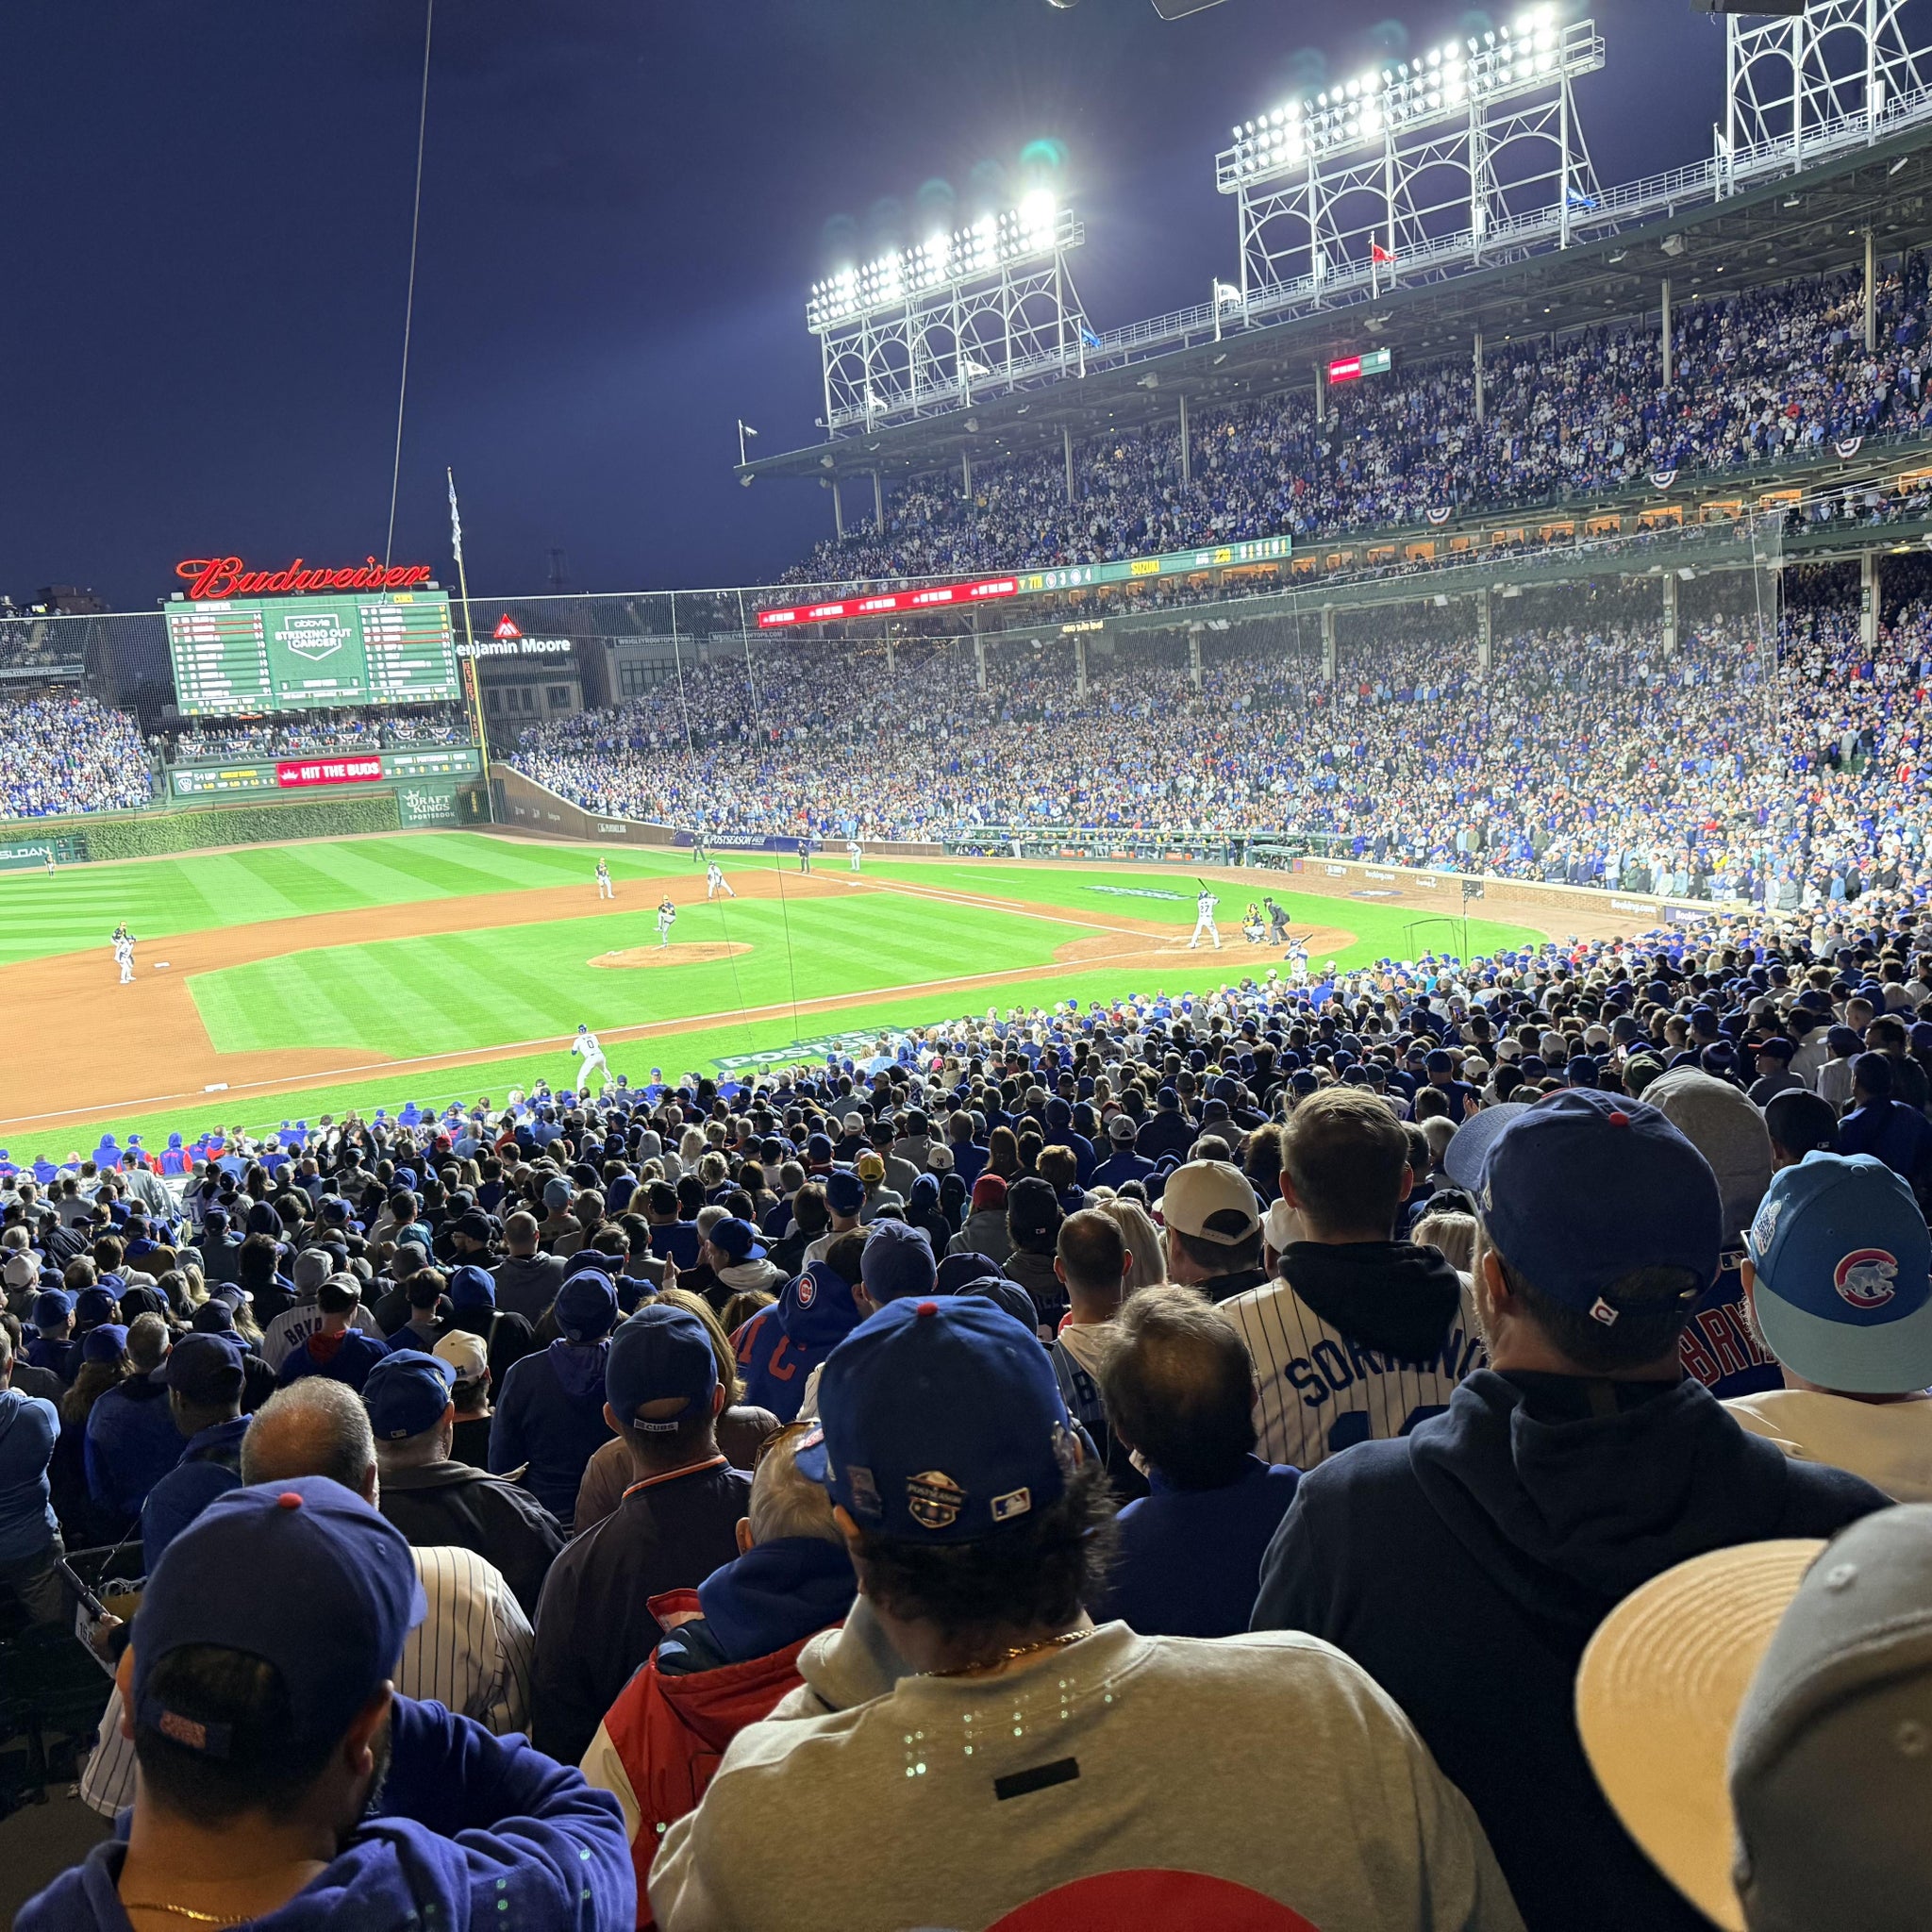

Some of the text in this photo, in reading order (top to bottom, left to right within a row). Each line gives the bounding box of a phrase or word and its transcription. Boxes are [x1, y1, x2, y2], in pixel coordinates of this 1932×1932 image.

[1131, 559, 1160, 575] SUZUKI
[175, 557, 430, 600] Budweiser
[275, 627, 352, 641] STRIKING OUT
[292, 638, 337, 648] CANCER
[456, 638, 571, 658] enjamin Moore
[300, 761, 380, 780] HIT THE BUDS
[407, 794, 451, 808] DRAFT
[413, 803, 451, 813] KINGS
[408, 811, 456, 822] SPORTSBOOK
[709, 834, 753, 846] POSTSEASON
[0, 846, 51, 859] SLOAN
[587, 1040, 594, 1049] 0
[1284, 1328, 1489, 1407] SORNO
